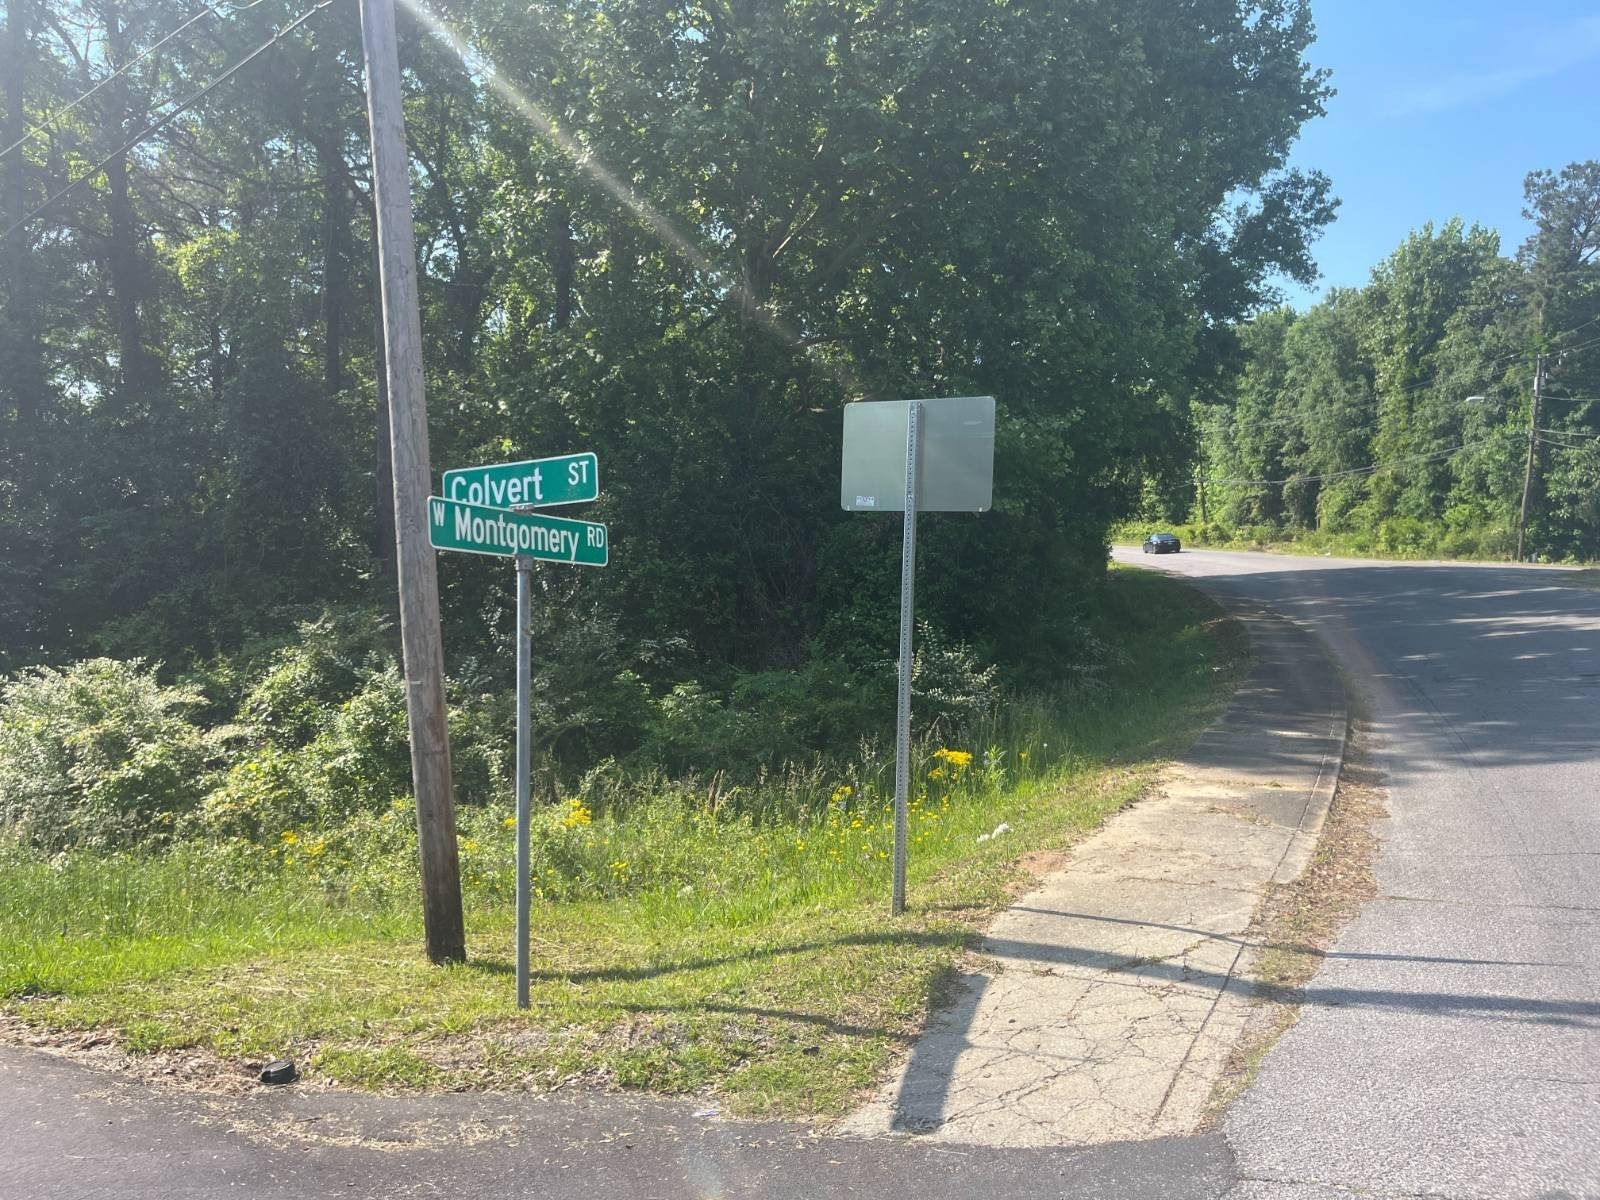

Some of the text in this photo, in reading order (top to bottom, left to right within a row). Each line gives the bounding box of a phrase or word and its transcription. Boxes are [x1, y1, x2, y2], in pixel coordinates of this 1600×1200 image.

[451, 460, 589, 505] Colvert ST
[433, 502, 604, 561] W Montgomery RD
